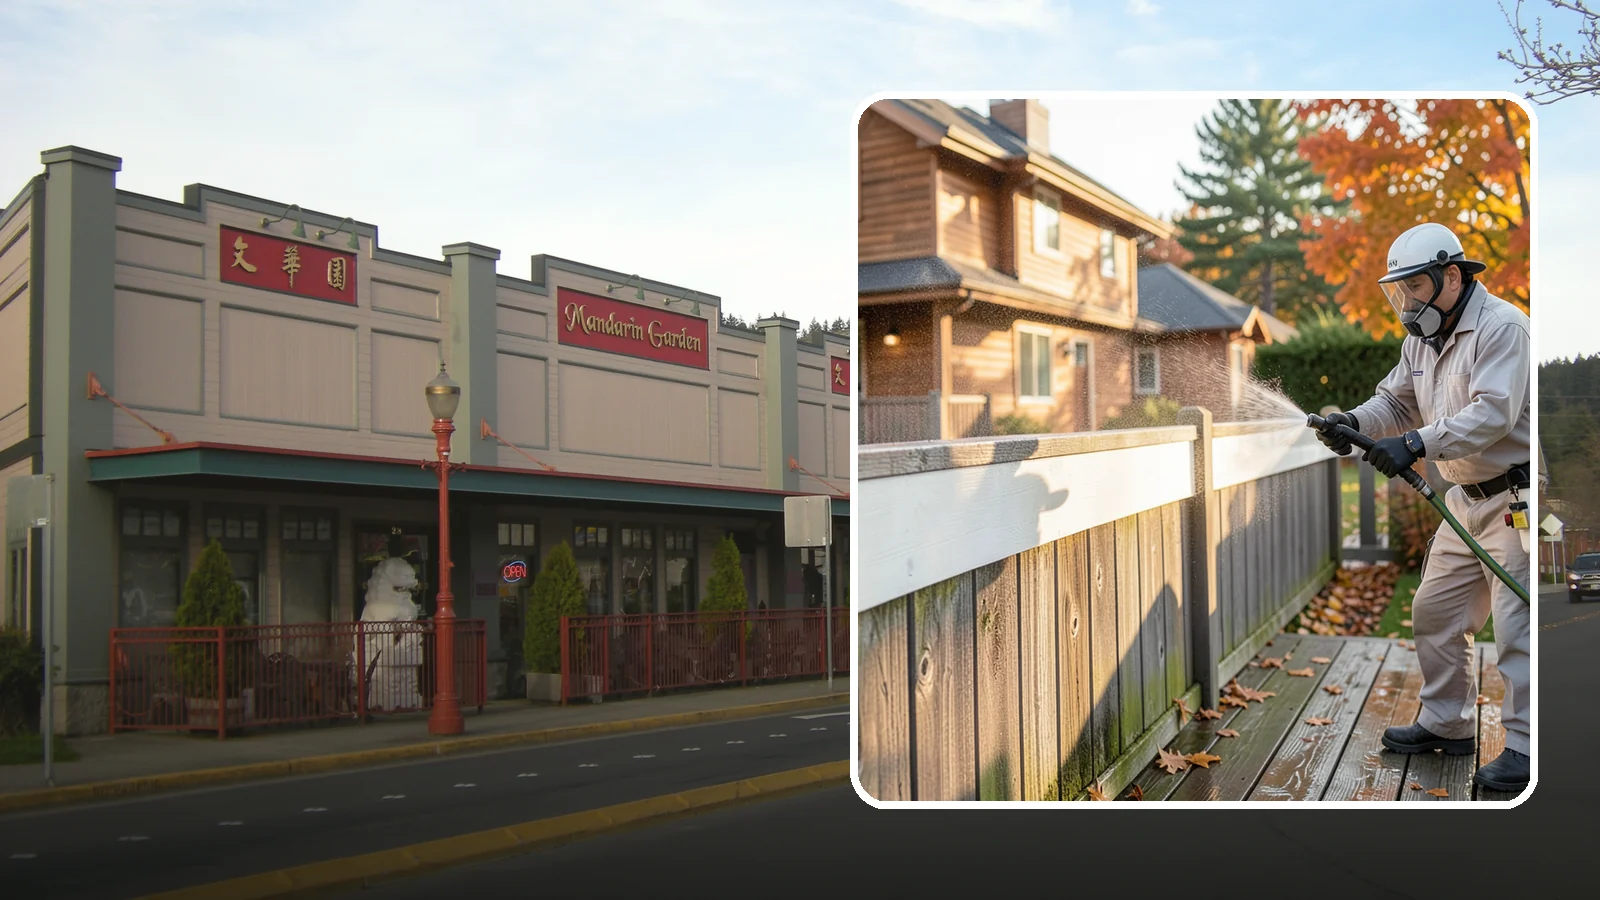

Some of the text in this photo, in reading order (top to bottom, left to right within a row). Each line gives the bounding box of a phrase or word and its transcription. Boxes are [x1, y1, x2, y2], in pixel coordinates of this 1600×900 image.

[231, 236, 346, 291] 文華園
[565, 302, 702, 352] Mandarin Garden
[835, 363, 846, 386] 文
[503, 566, 526, 578] OPEN
